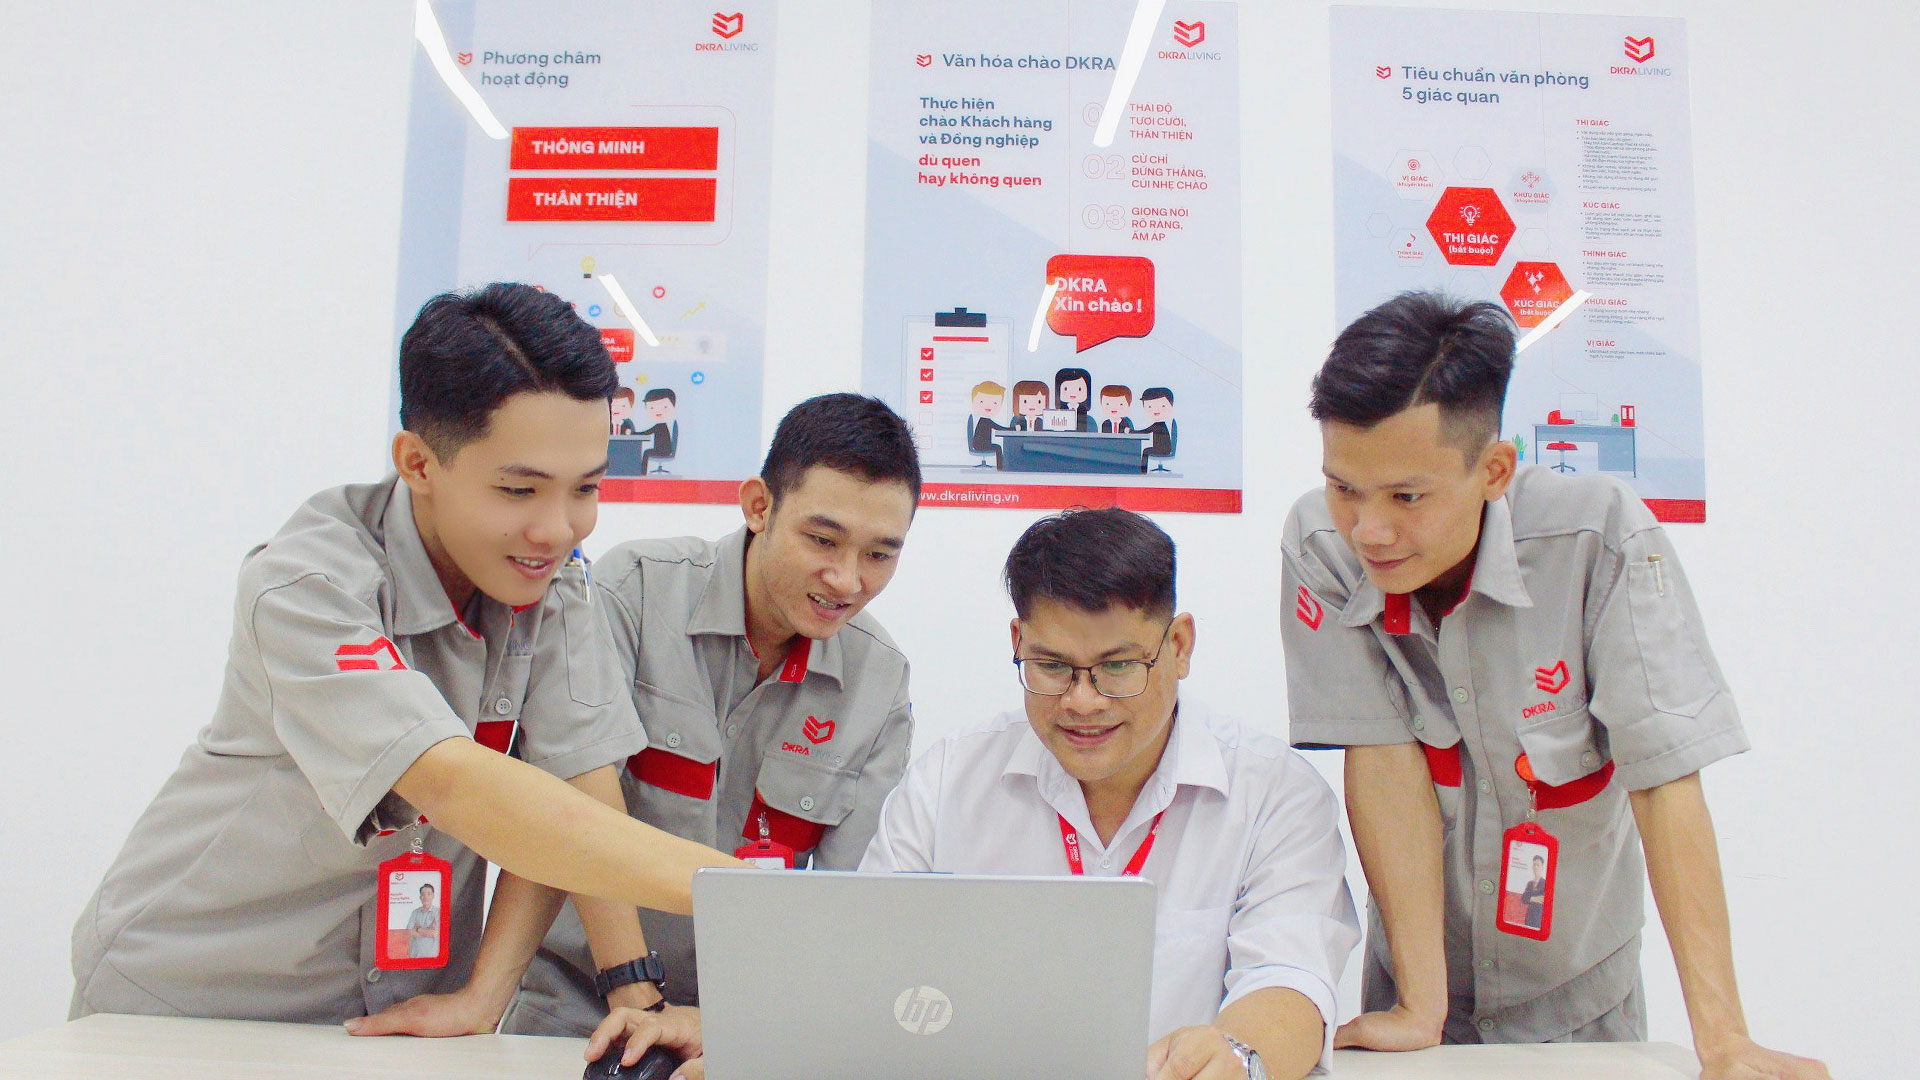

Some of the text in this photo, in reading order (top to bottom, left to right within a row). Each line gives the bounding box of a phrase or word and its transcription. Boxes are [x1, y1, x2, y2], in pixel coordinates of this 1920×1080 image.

[483, 51, 601, 66] Phương châm
[942, 54, 1116, 70] Văn hóa chào DKRA
[482, 72, 570, 88] hoạt động
[1401, 66, 1590, 89] Tiêu chuẩn văn phòng
[920, 97, 995, 112] Thực hiện
[1402, 87, 1500, 106] 5 giác quan
[919, 115, 1053, 131] chào Khách hàng
[532, 138, 645, 155] THÔNG MINH
[919, 132, 1040, 149] và Đồng nghiệp
[918, 154, 981, 169] dù quen
[1082, 154, 1126, 180] 02
[918, 172, 1042, 188] hay không quen
[533, 190, 638, 209] THÂN THIỆN
[1082, 204, 1126, 230] 03
[1443, 231, 1499, 245] THỊ GIÁC
[1054, 277, 1108, 293] DKRA
[1054, 296, 1142, 313] Xin chào !
[920, 490, 1020, 504] ww.dkraliving.vn
[1522, 701, 1557, 719] DKRA
[781, 741, 810, 756] DKRA
[894, 986, 953, 1035] hp
